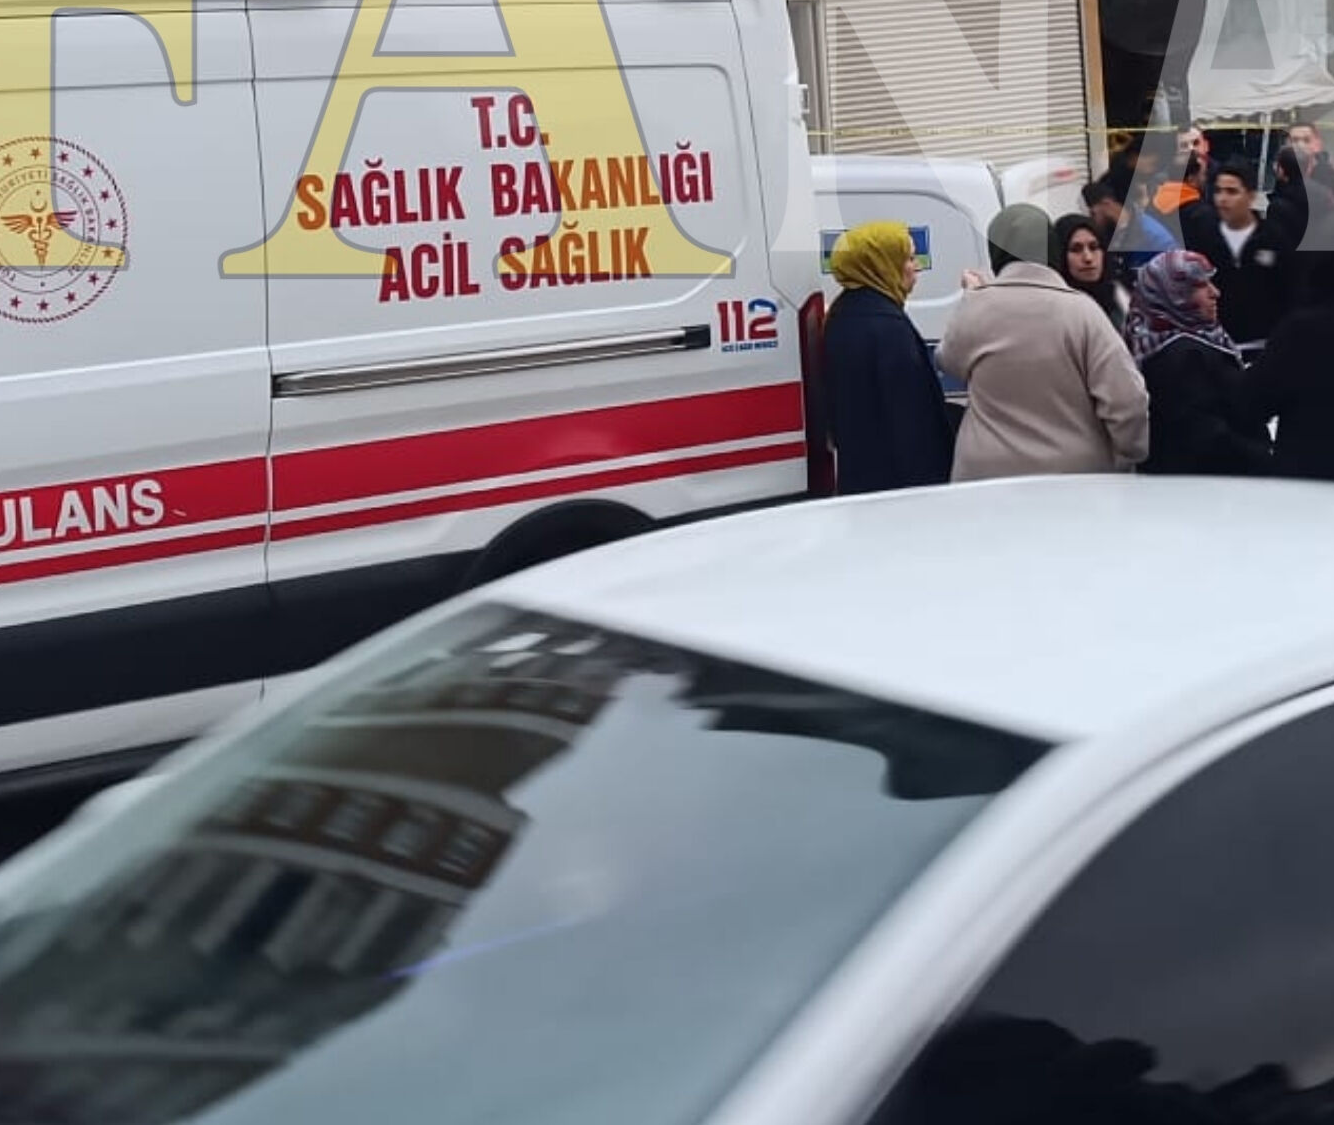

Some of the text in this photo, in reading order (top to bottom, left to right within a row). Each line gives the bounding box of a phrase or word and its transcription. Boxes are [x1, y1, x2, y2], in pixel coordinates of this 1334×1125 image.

[471, 94, 549, 150] T.C.
[296, 140, 713, 230] SAĞLIK BAKANLIĞI
[379, 220, 653, 303] ACİL SAĞLIK
[717, 299, 778, 342] 112
